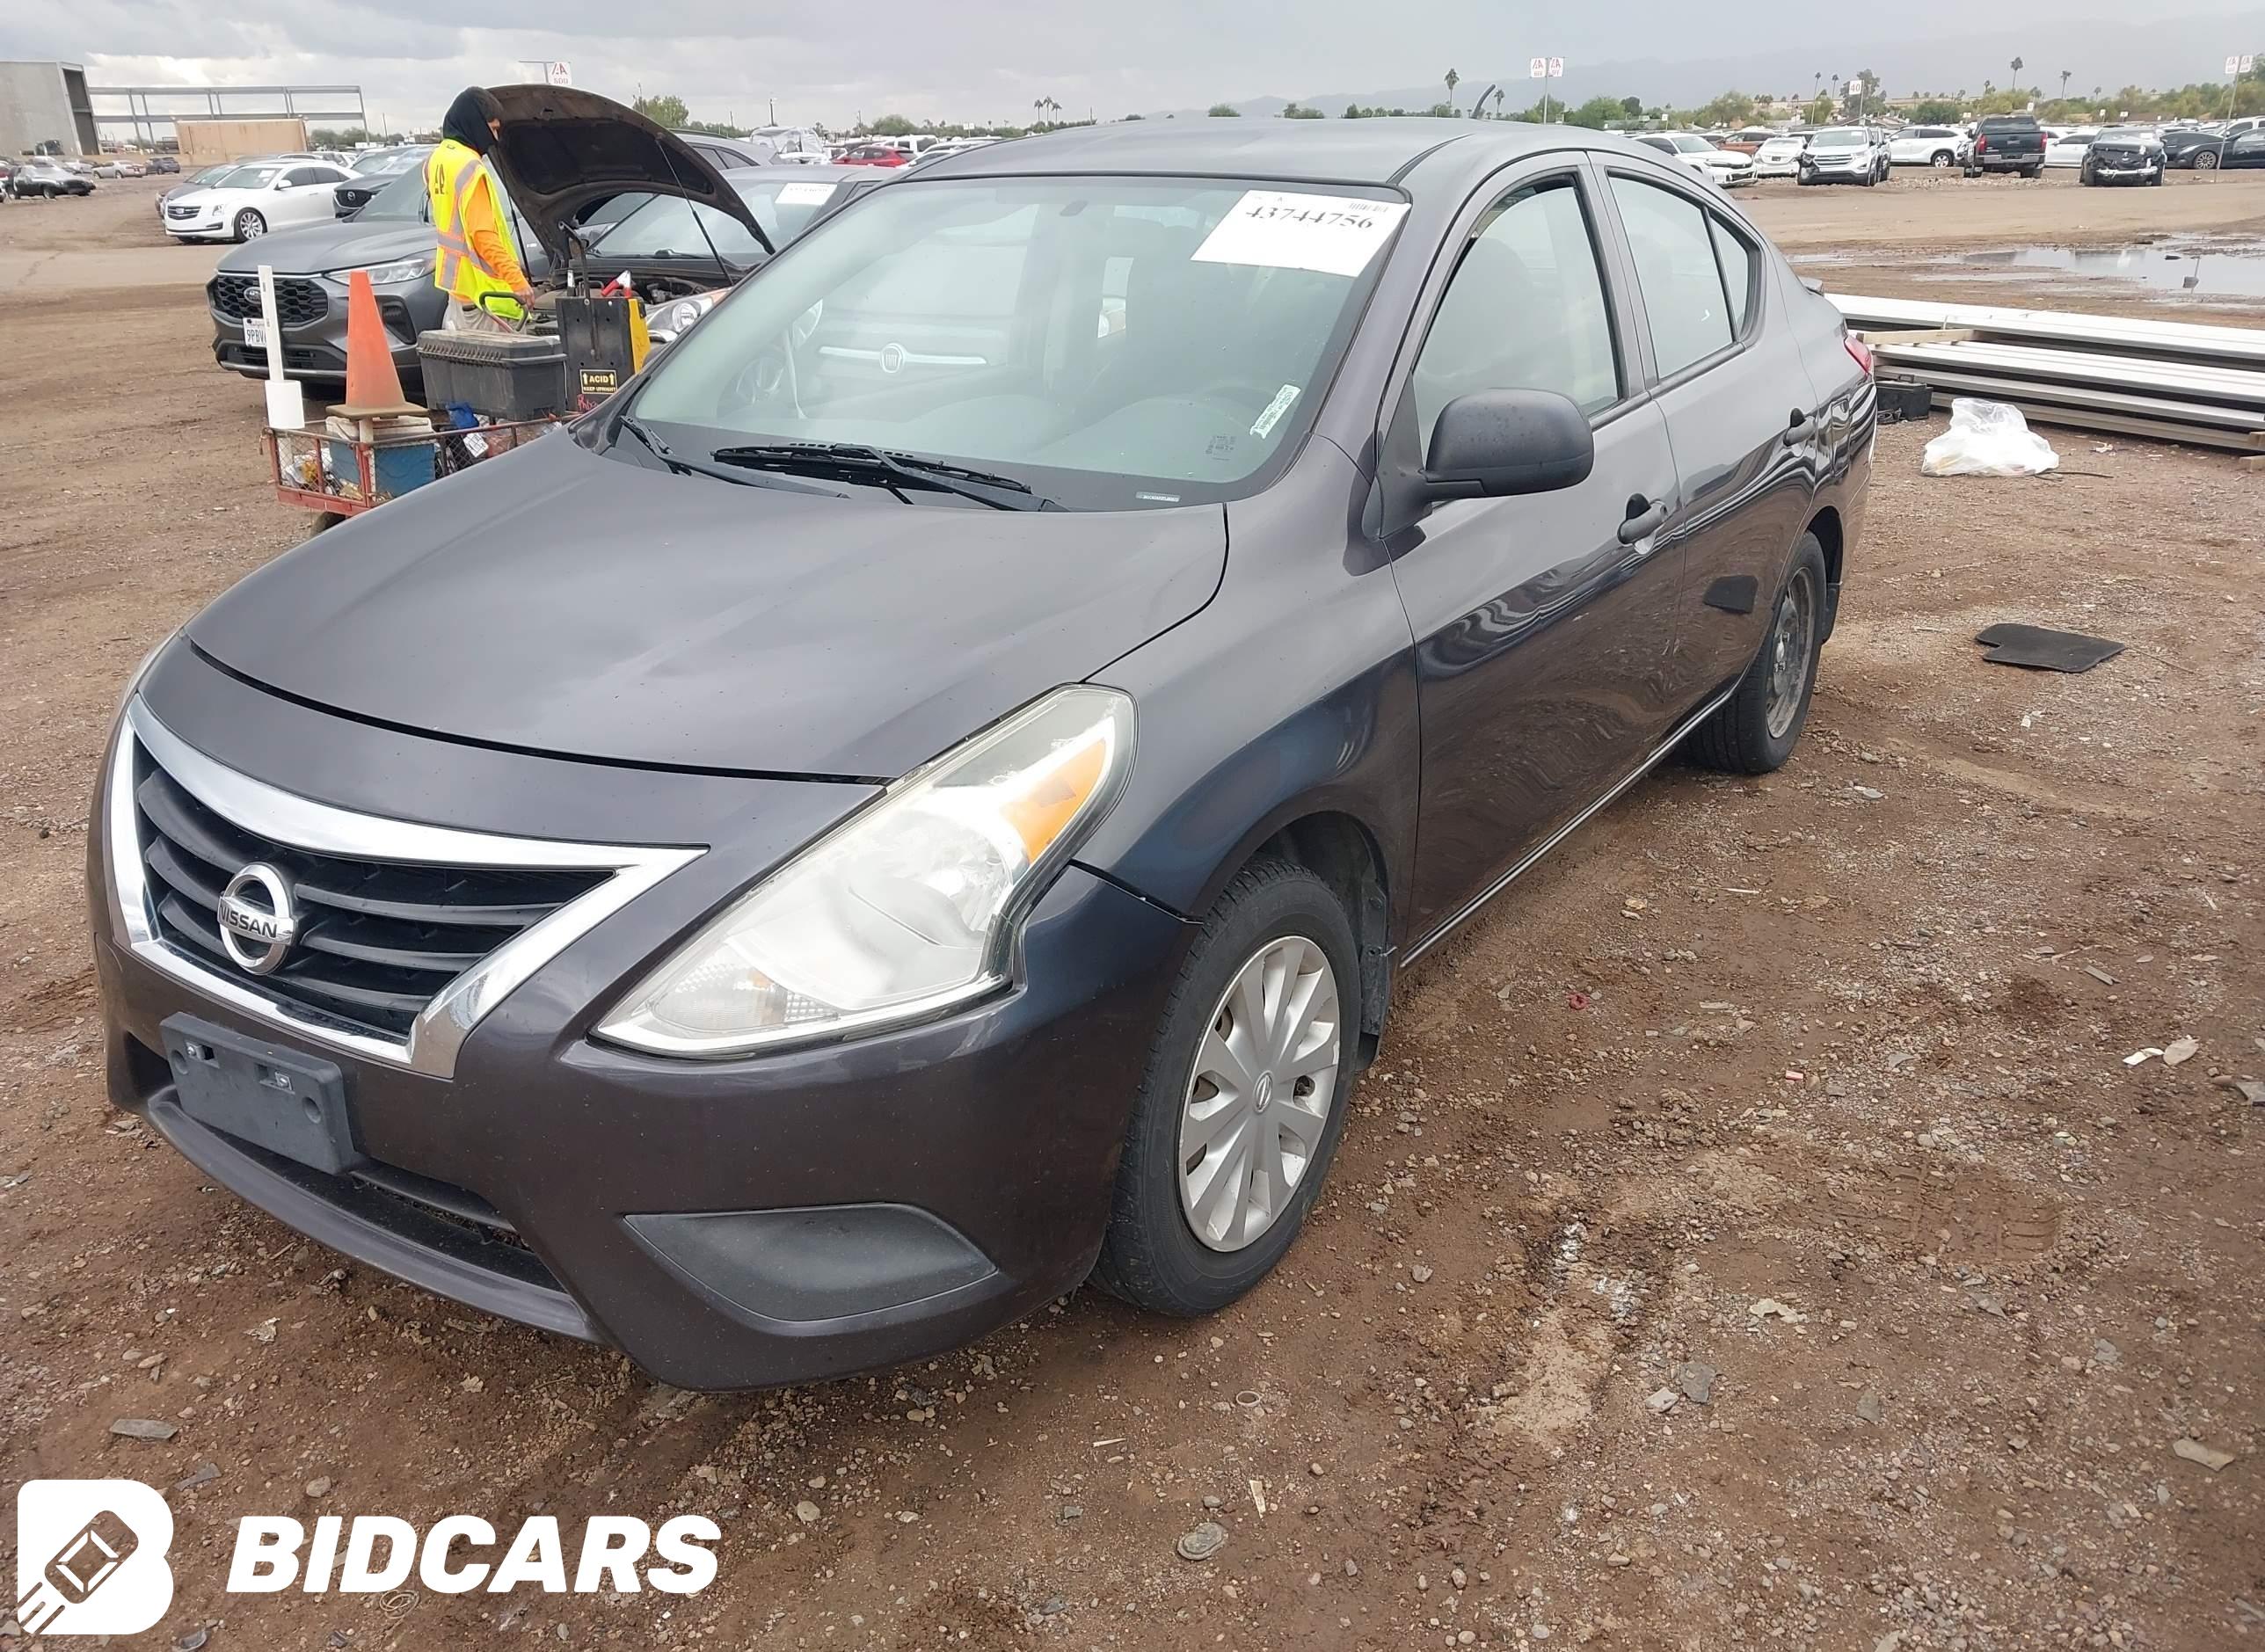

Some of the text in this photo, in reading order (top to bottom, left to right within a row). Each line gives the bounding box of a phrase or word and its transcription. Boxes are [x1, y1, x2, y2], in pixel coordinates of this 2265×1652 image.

[1245, 206, 1374, 229] 43744756
[589, 375, 609, 383] ACID
[220, 903, 278, 939] NISSAN
